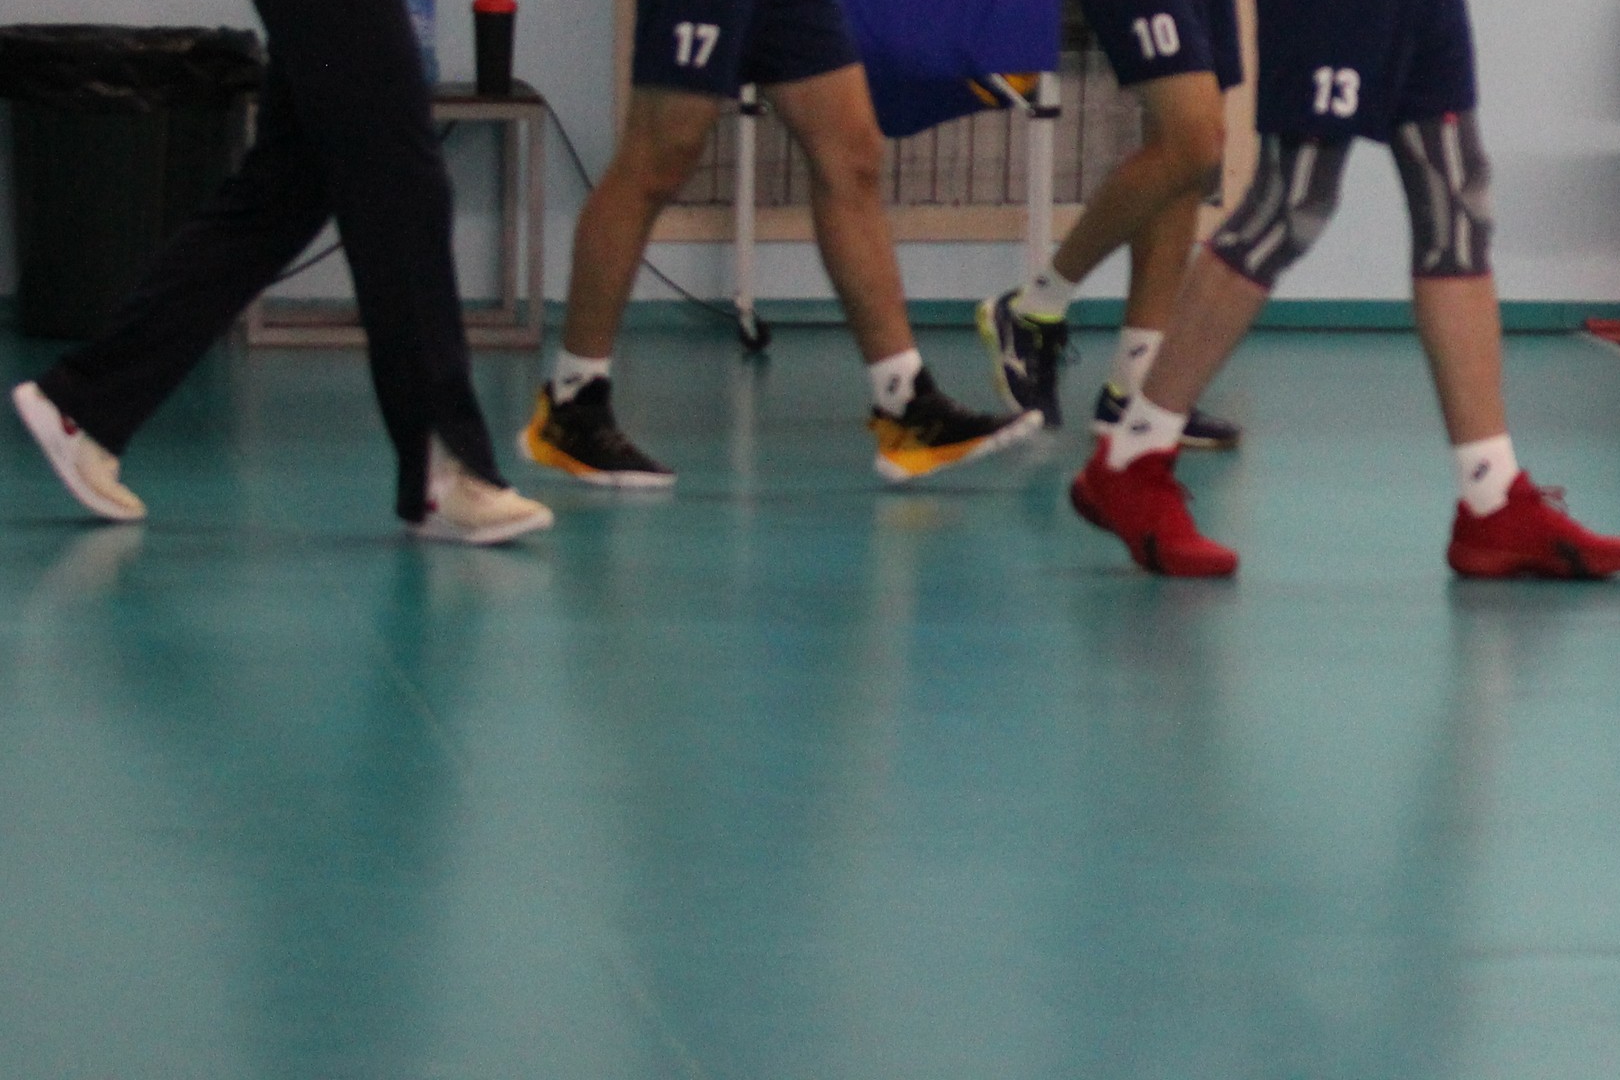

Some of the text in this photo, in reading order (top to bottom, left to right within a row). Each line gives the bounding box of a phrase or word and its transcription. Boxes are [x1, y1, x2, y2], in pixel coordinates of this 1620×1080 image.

[675, 21, 720, 67] 17
[1132, 13, 1180, 60] 10
[1313, 66, 1361, 118] 13
